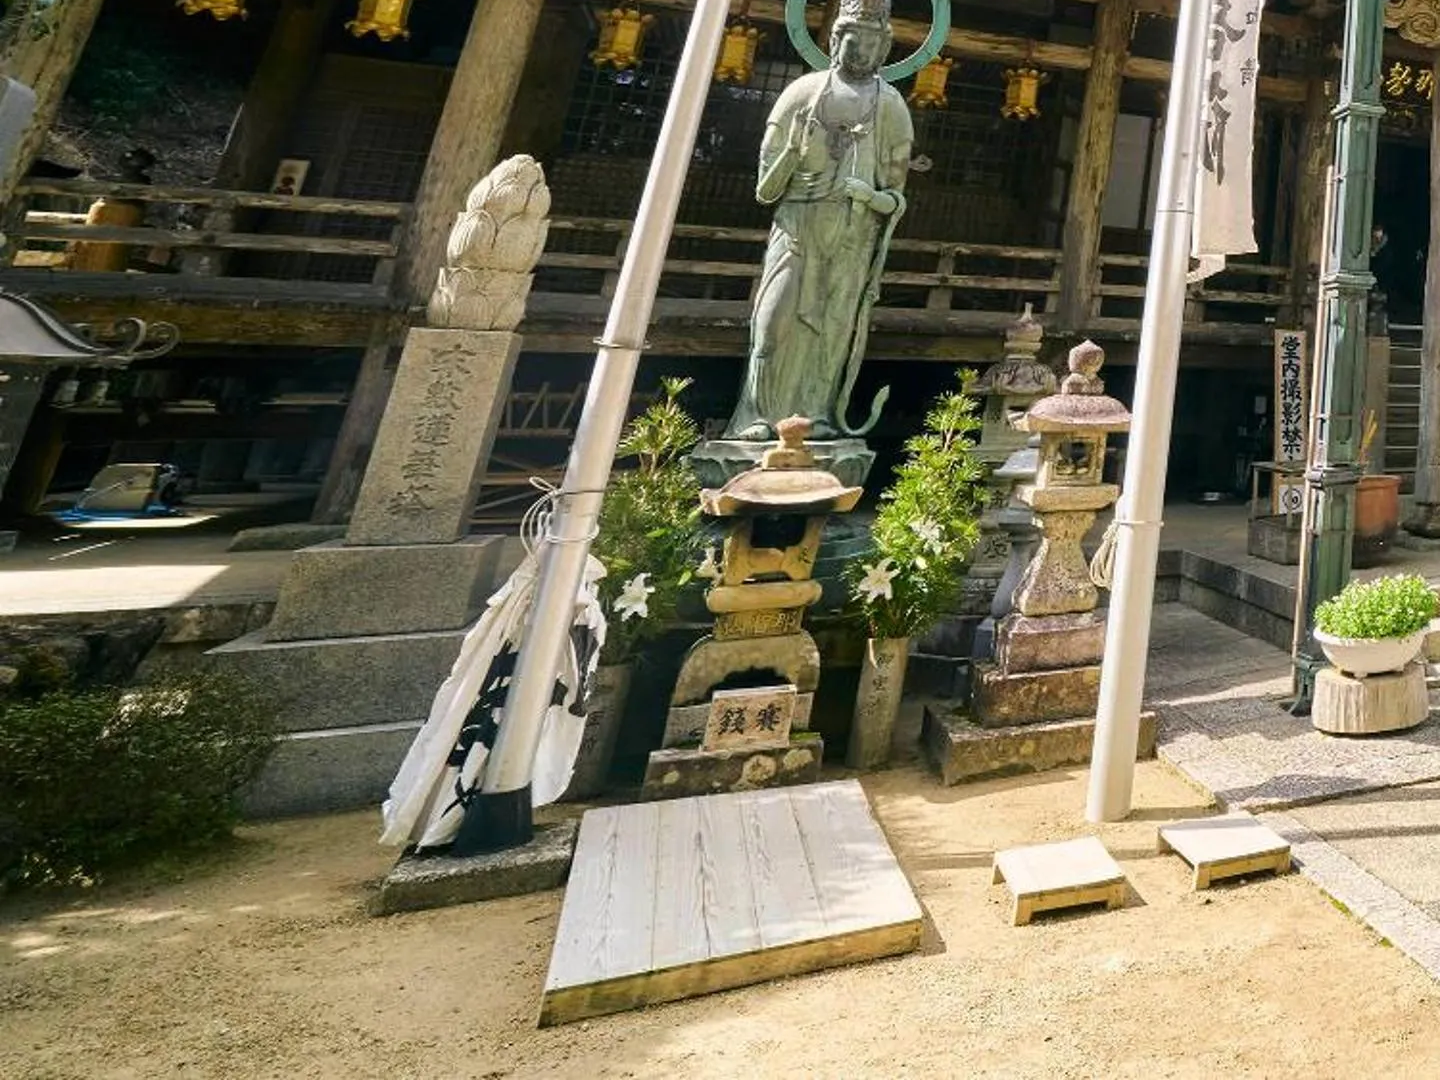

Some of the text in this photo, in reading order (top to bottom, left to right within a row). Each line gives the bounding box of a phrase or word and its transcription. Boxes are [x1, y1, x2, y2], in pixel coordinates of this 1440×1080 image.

[1280, 336, 1302, 460] 堂内撮影禁
